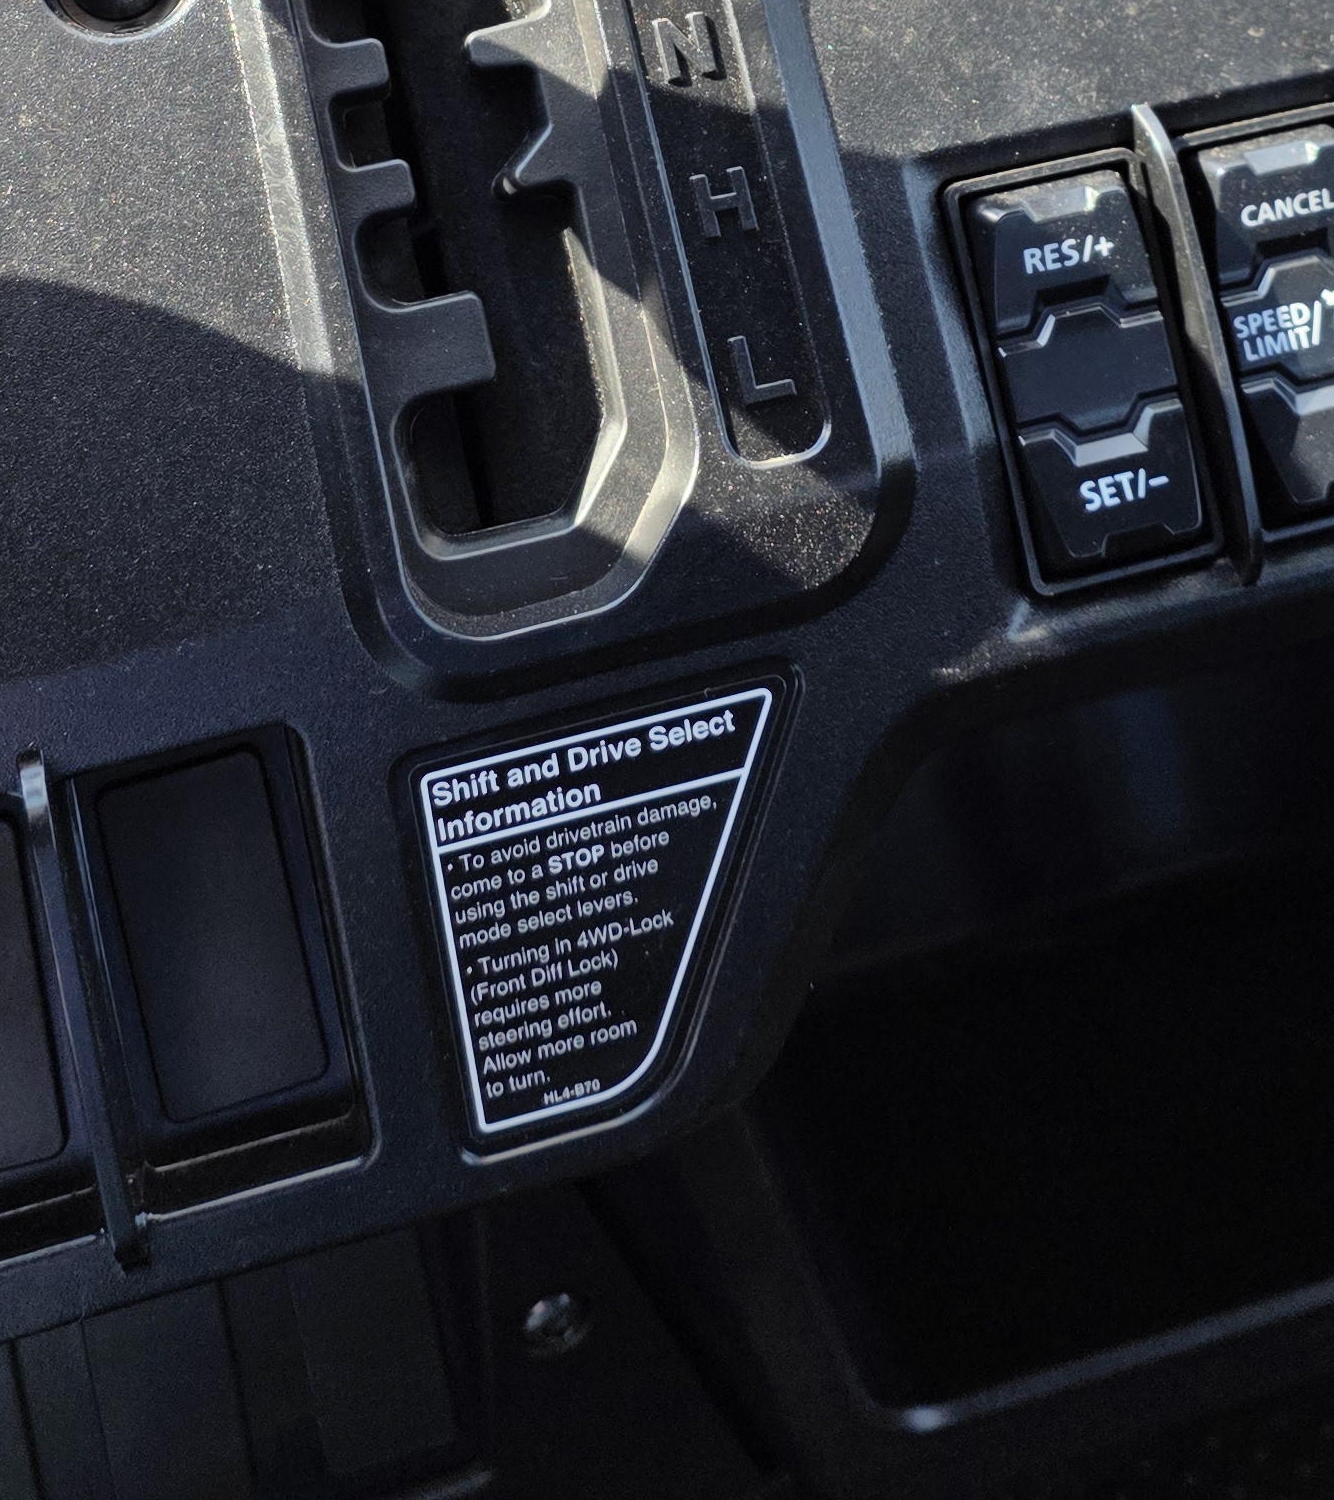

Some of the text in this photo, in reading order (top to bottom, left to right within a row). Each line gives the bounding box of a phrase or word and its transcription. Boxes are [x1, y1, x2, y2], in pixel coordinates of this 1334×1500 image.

[652, 12, 723, 86] N
[689, 166, 759, 238] H
[1022, 234, 1115, 275] RES/+
[1233, 302, 1311, 339] SPEED
[727, 336, 797, 406] L
[1079, 467, 1170, 513] SET/-
[431, 709, 736, 807] Shift and Drive Select
[438, 783, 602, 843] Information
[459, 793, 718, 873] To avoid drivetrain damage,
[450, 831, 670, 900] come to a STOP before
[455, 857, 660, 926] using the shift or drive
[459, 891, 639, 949] mode select levers.
[477, 909, 674, 976] Turning in 4WD-Lock
[470, 949, 620, 1005] (Front Diff Lock)
[474, 980, 603, 1029] requires more
[478, 999, 612, 1052] steering effort.
[482, 1018, 638, 1075] Allow more room
[485, 1068, 551, 1099] to turn.
[543, 1077, 601, 1106] HL4-B70
